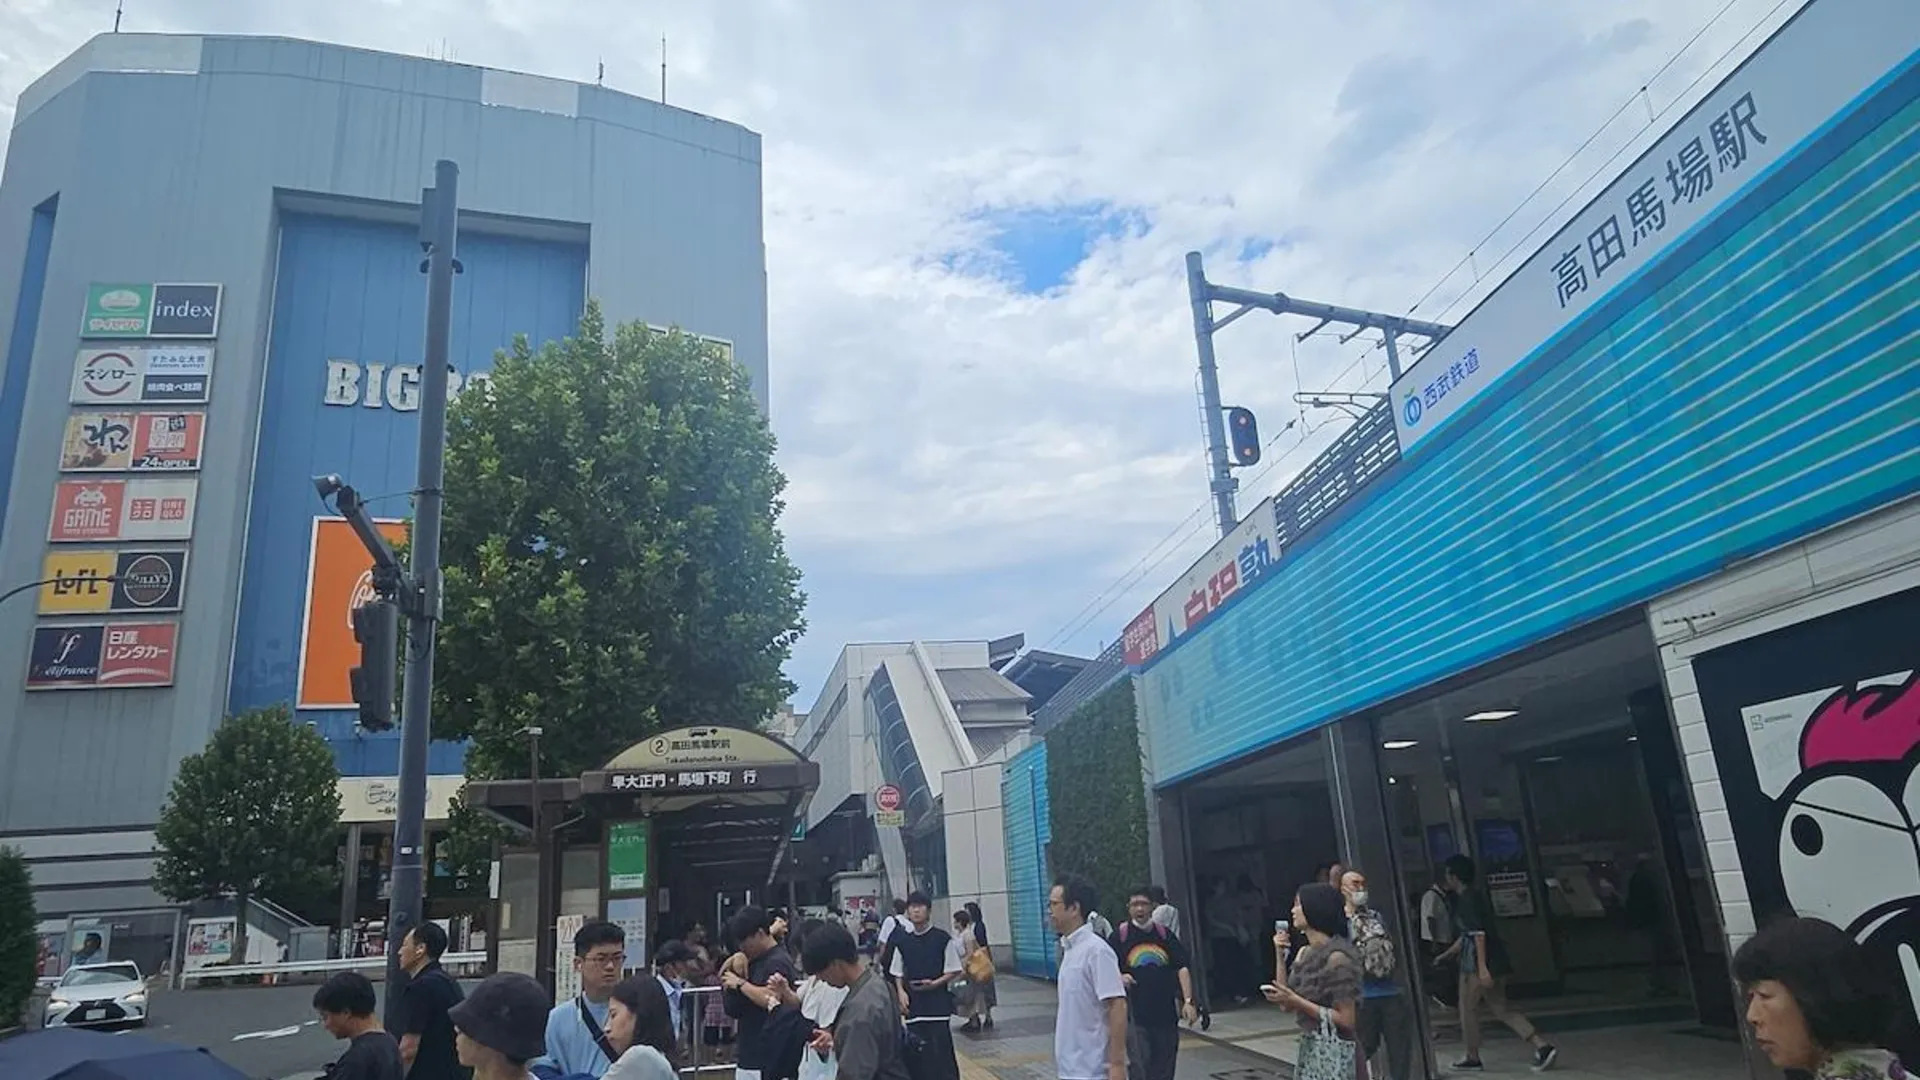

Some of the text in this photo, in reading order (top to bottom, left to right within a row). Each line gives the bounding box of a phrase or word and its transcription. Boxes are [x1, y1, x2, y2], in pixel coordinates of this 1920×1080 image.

[1550, 92, 1767, 308] 高田馬場駅
[155, 300, 213, 317] index
[81, 368, 137, 380] スシロー
[1424, 348, 1480, 410] 西武鉄道
[63, 508, 112, 528] GAME
[109, 631, 139, 644] 日産
[107, 646, 169, 659] レンタカー
[671, 739, 730, 750] 高田馬場駅前
[612, 770, 757, 789] 早大正門・馬場下町 行
